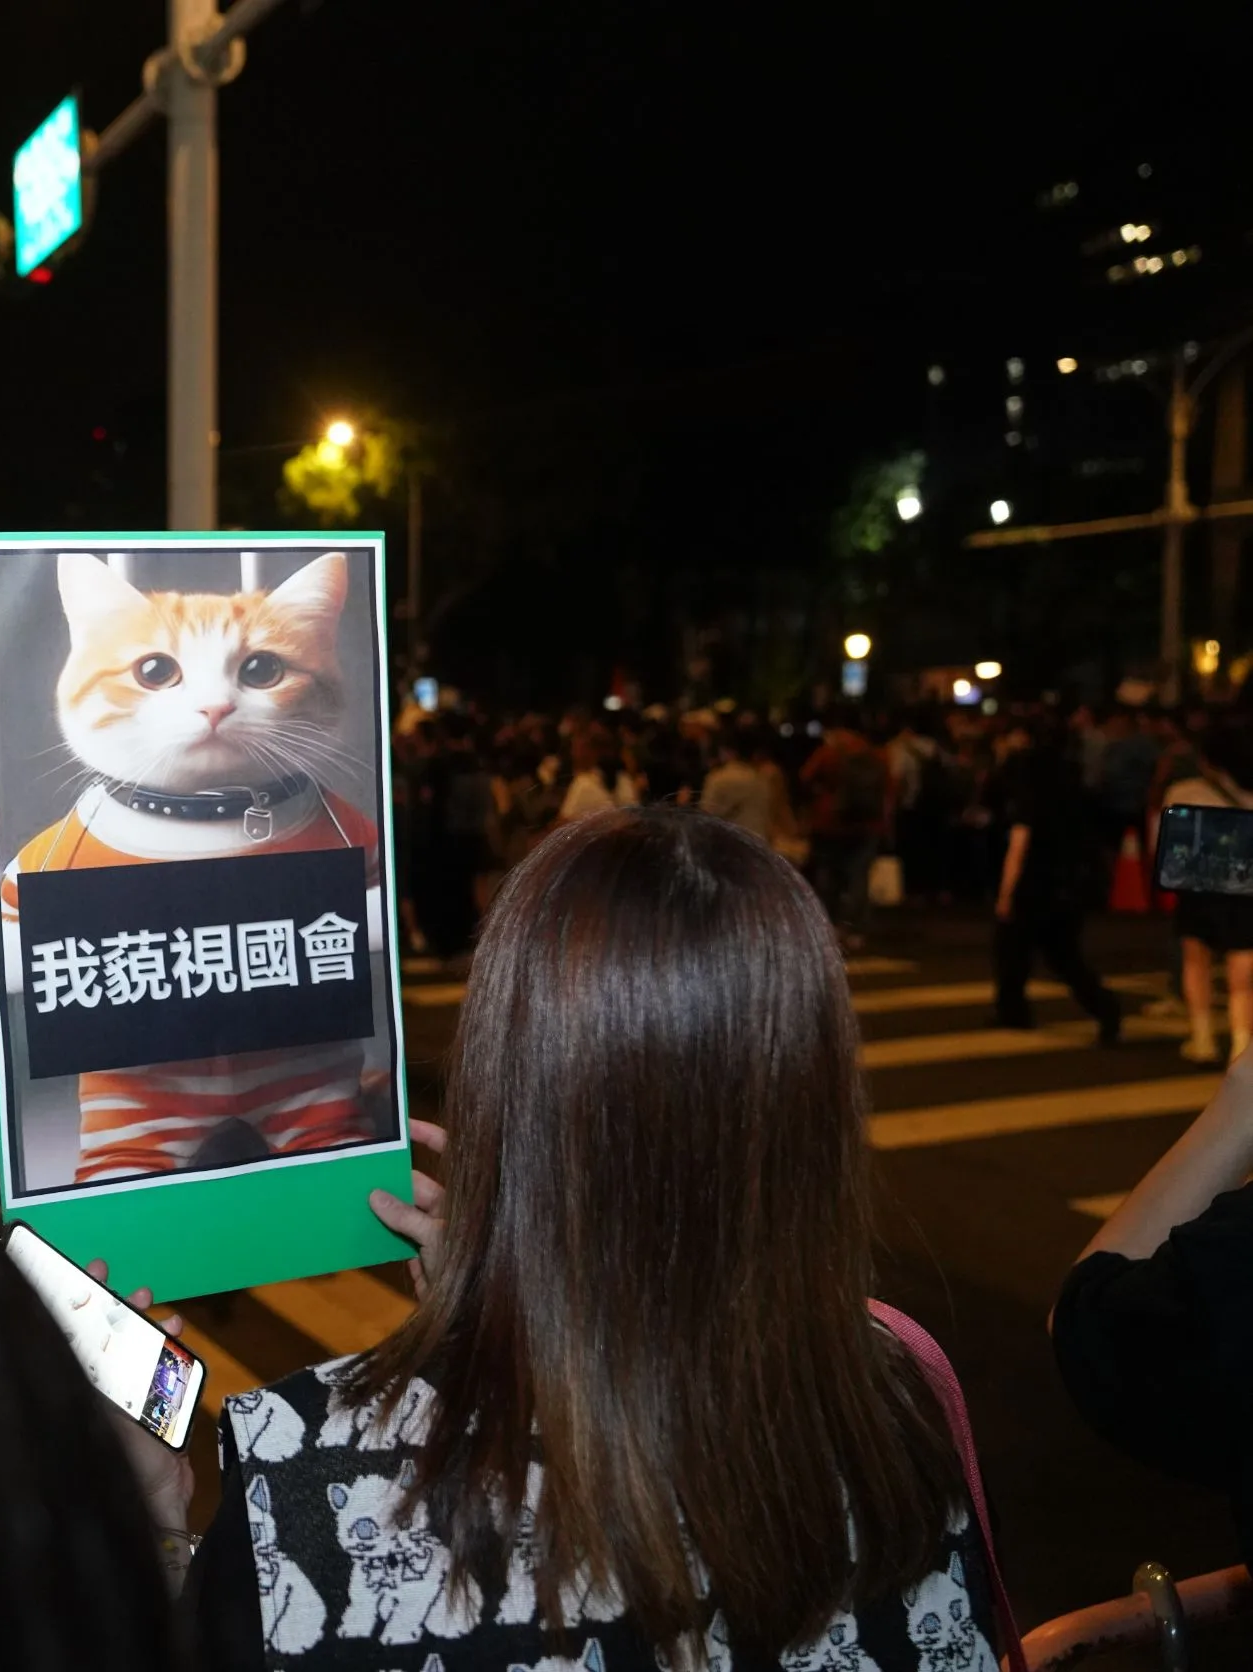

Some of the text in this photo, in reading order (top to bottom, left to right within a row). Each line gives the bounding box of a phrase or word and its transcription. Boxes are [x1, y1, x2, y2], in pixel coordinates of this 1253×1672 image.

[31, 912, 359, 1013] 我藐視國會
